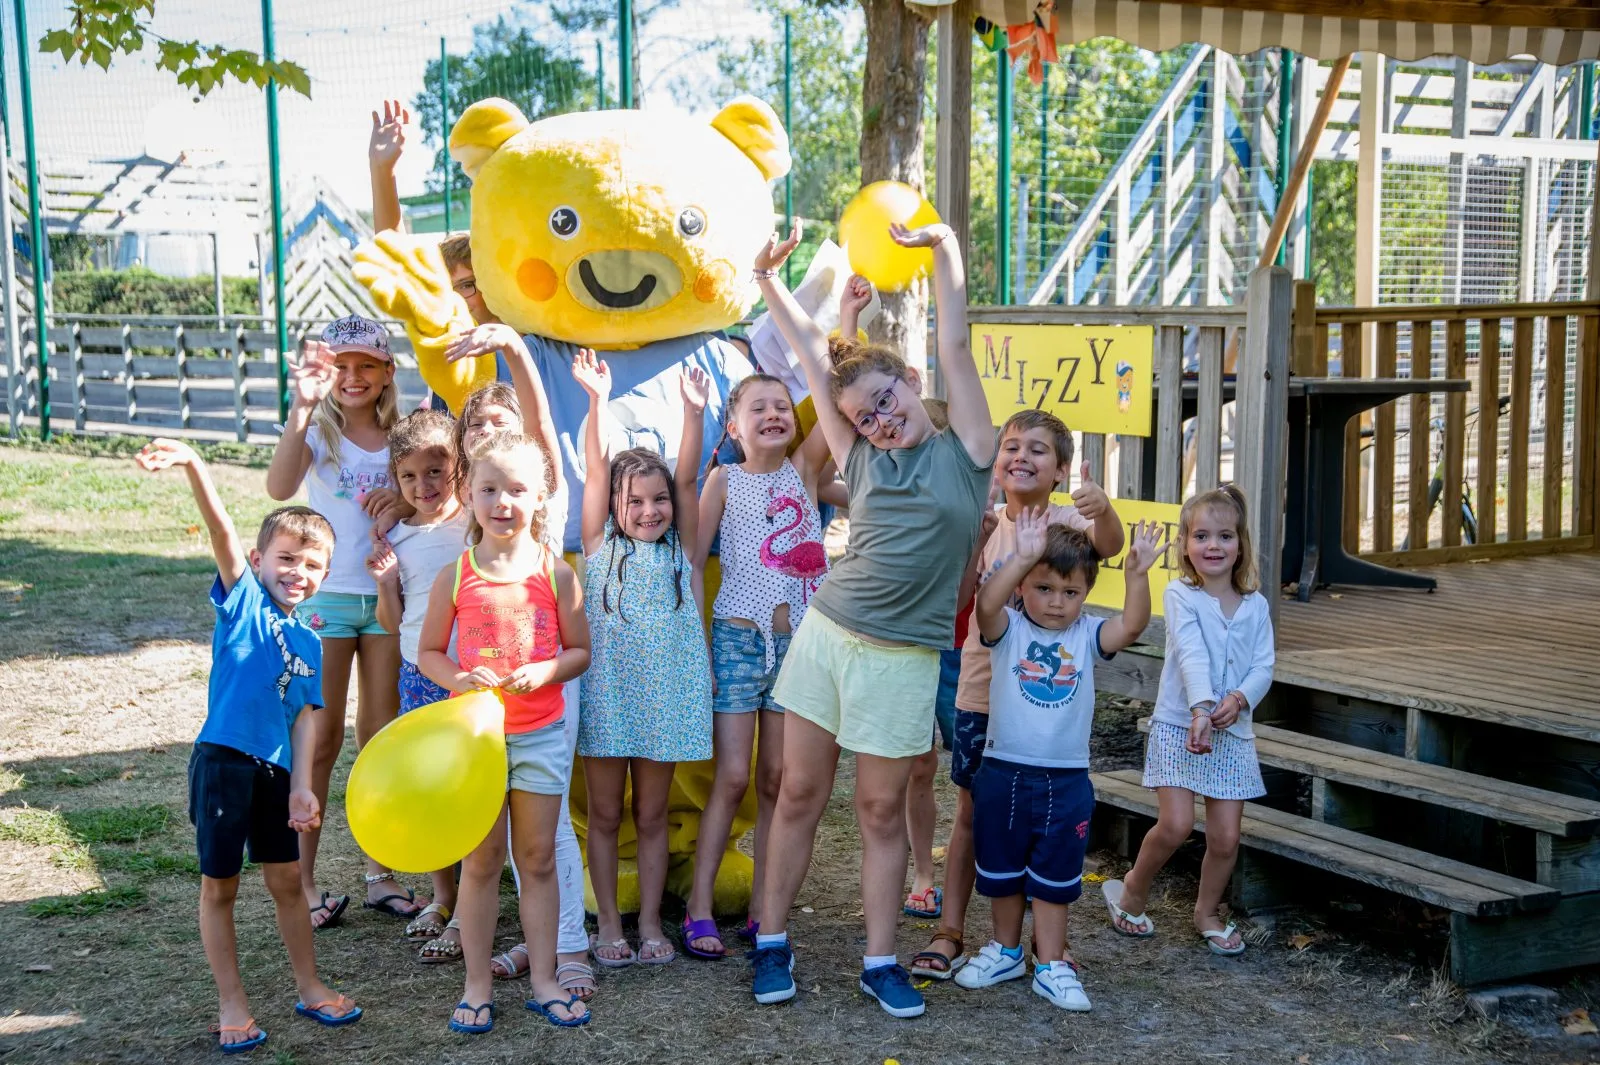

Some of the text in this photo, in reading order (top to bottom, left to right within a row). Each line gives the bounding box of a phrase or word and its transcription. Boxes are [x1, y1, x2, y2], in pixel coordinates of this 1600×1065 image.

[335, 320, 376, 334] WILD
[981, 334, 1115, 414] MIZZY
[1021, 692, 1050, 709] SUMMER
[1061, 696, 1074, 707] FUN
